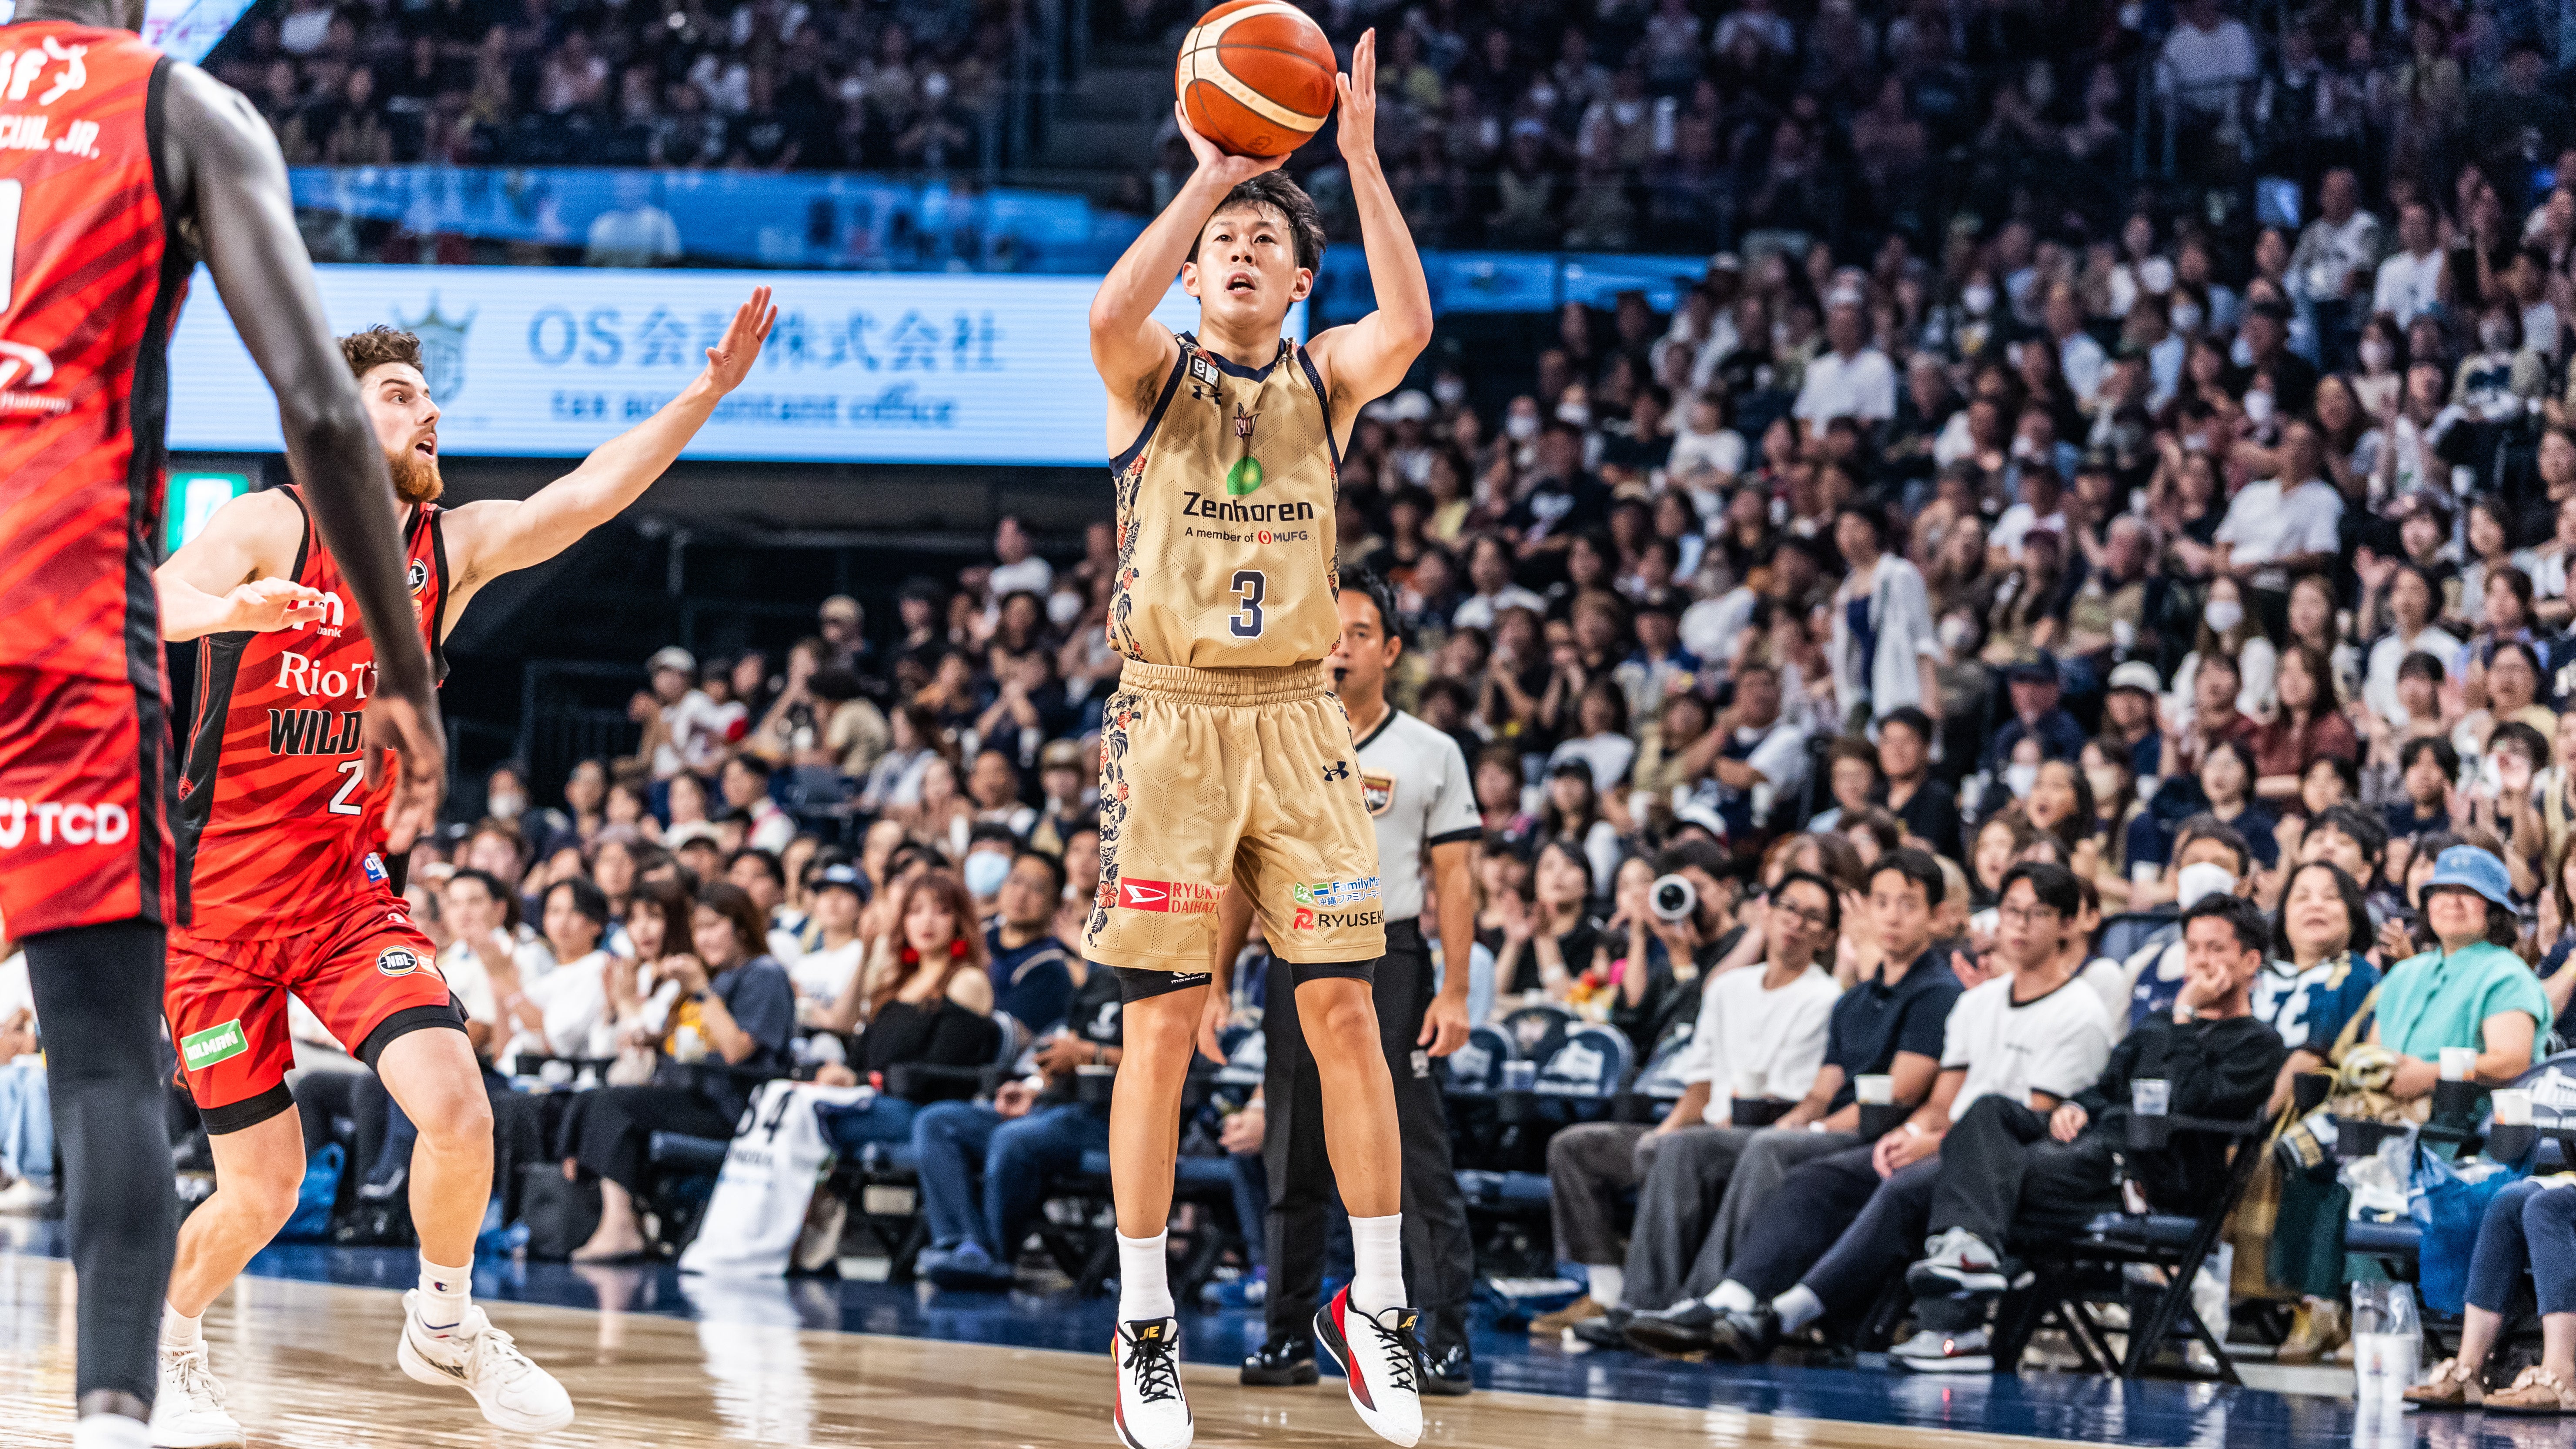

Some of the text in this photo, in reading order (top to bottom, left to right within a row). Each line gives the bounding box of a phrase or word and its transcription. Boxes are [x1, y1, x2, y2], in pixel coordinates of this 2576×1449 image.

[54, 119, 100, 160] JR.
[1183, 491, 1314, 522] Zenhoren
[1185, 527, 1307, 542] A member of MUFG
[1228, 569, 1266, 639] 3
[317, 624, 342, 638] bank
[267, 709, 368, 756] WILD
[328, 759, 365, 816] 2
[32, 802, 129, 845] TCD
[1333, 876, 1380, 893] FamilyMar
[1172, 900, 1217, 914] DAIHAT
[1318, 910, 1384, 927] RYUSEKI
[385, 954, 411, 968] NBL
[185, 1030, 239, 1061] HOLMAN
[1139, 1325, 1160, 1341] JE
